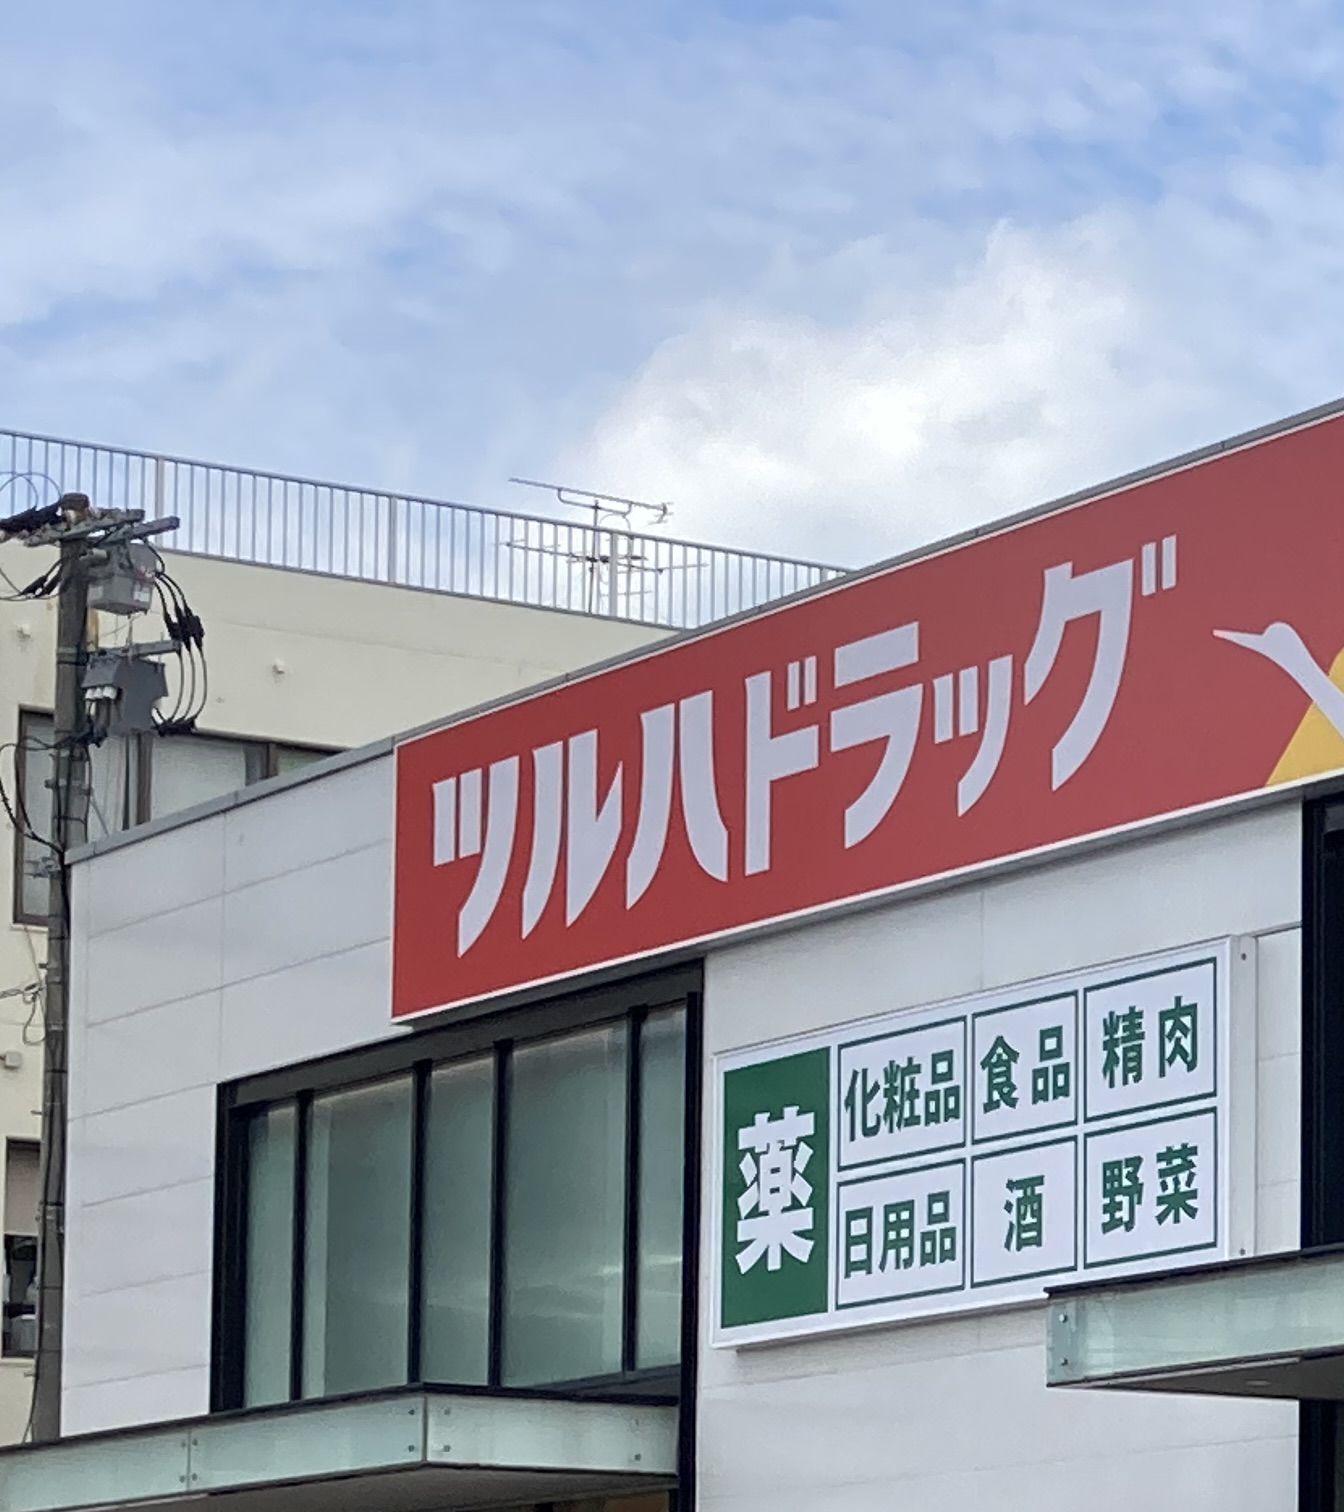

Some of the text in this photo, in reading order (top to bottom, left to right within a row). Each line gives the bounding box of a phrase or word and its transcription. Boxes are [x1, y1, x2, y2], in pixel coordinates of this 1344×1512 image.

[432, 534, 1177, 957] ツルハドラッグ
[844, 996, 1199, 1142] 化粧品 食品 精肉
[735, 1105, 815, 1274] 薬
[844, 1143, 1199, 1279] 日用品 酒 野菜
